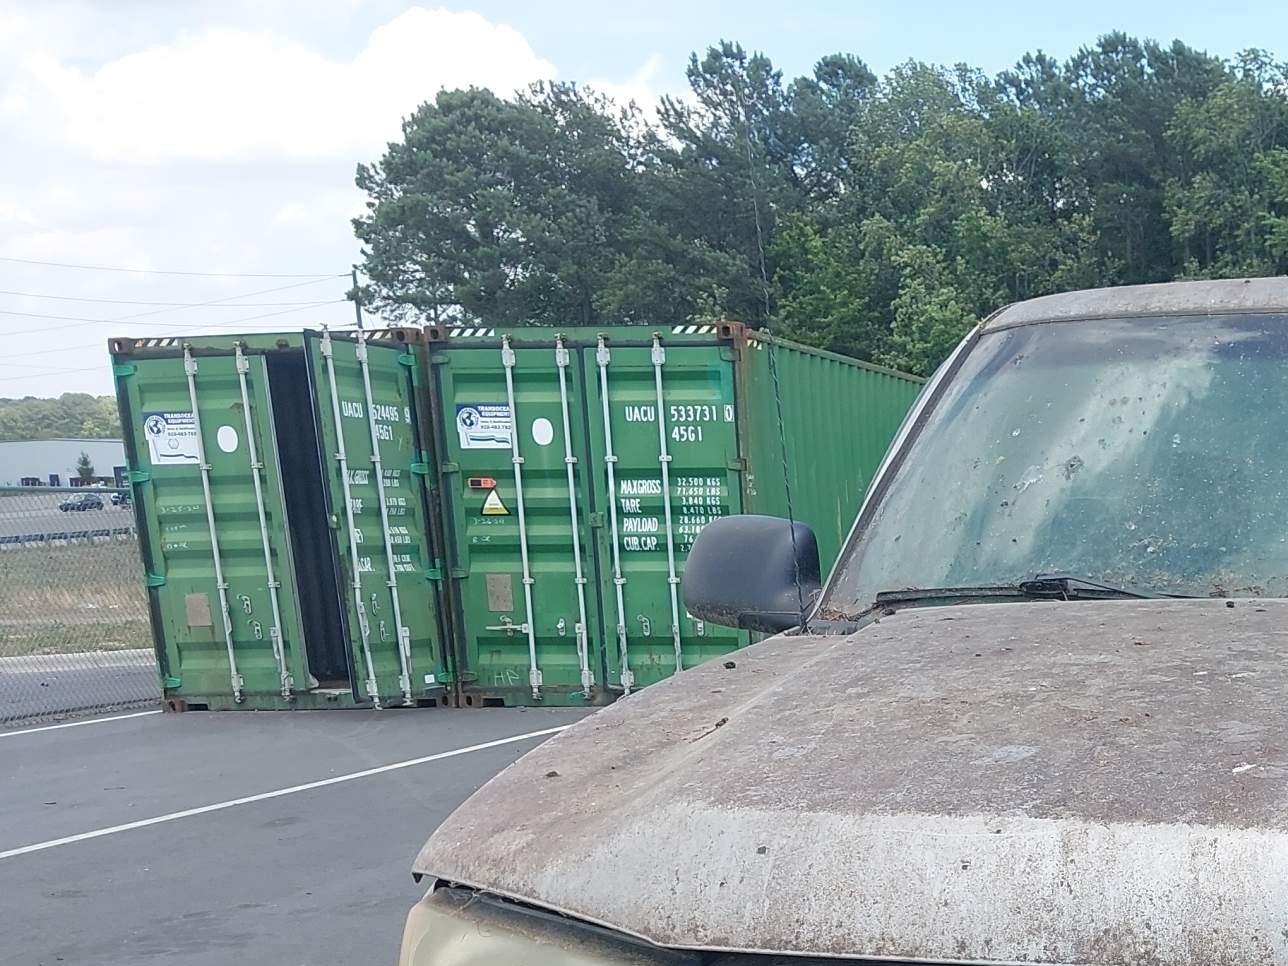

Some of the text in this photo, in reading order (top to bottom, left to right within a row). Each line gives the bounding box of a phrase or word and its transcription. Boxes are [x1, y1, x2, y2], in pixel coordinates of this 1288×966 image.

[341, 400, 364, 418] UACU
[624, 405, 735, 422] UACU 533731 0
[671, 426, 703, 442] 45G1
[677, 477, 704, 486] 32.500
[706, 478, 721, 486] KGS
[706, 487, 721, 496] LBS
[620, 498, 642, 513] TARE
[706, 496, 721, 505] KGS
[623, 517, 659, 532] PAYLOAD
